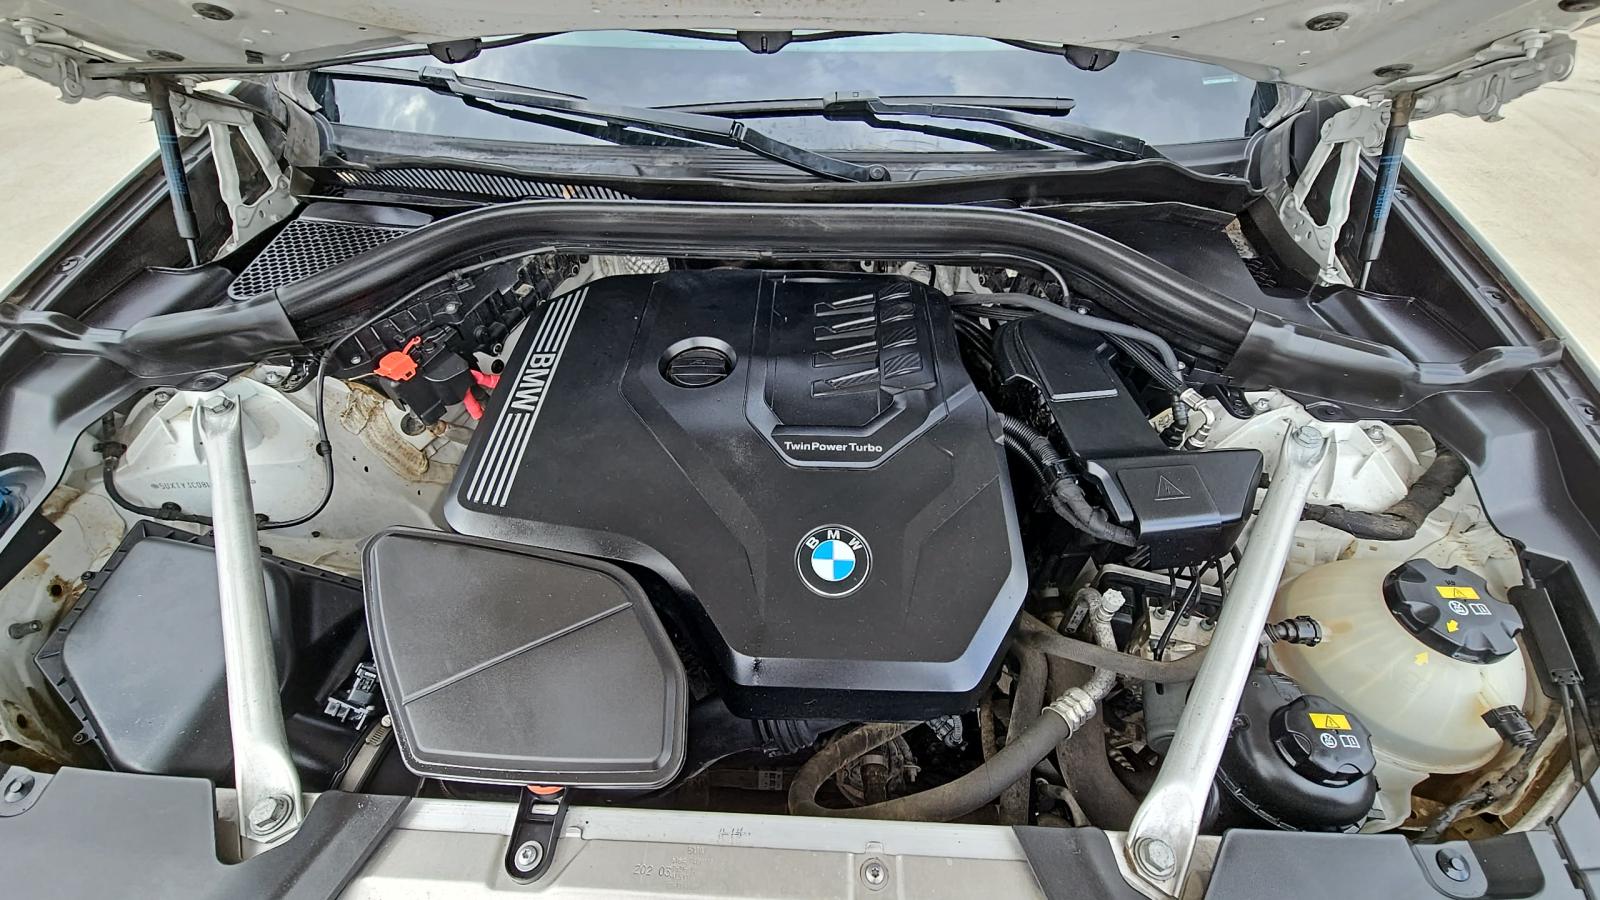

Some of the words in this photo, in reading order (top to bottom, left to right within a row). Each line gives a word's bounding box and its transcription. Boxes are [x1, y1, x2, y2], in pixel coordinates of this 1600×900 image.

[511, 353, 557, 411] BMW
[848, 442, 883, 453] Turbo
[805, 529, 863, 551] BMW
